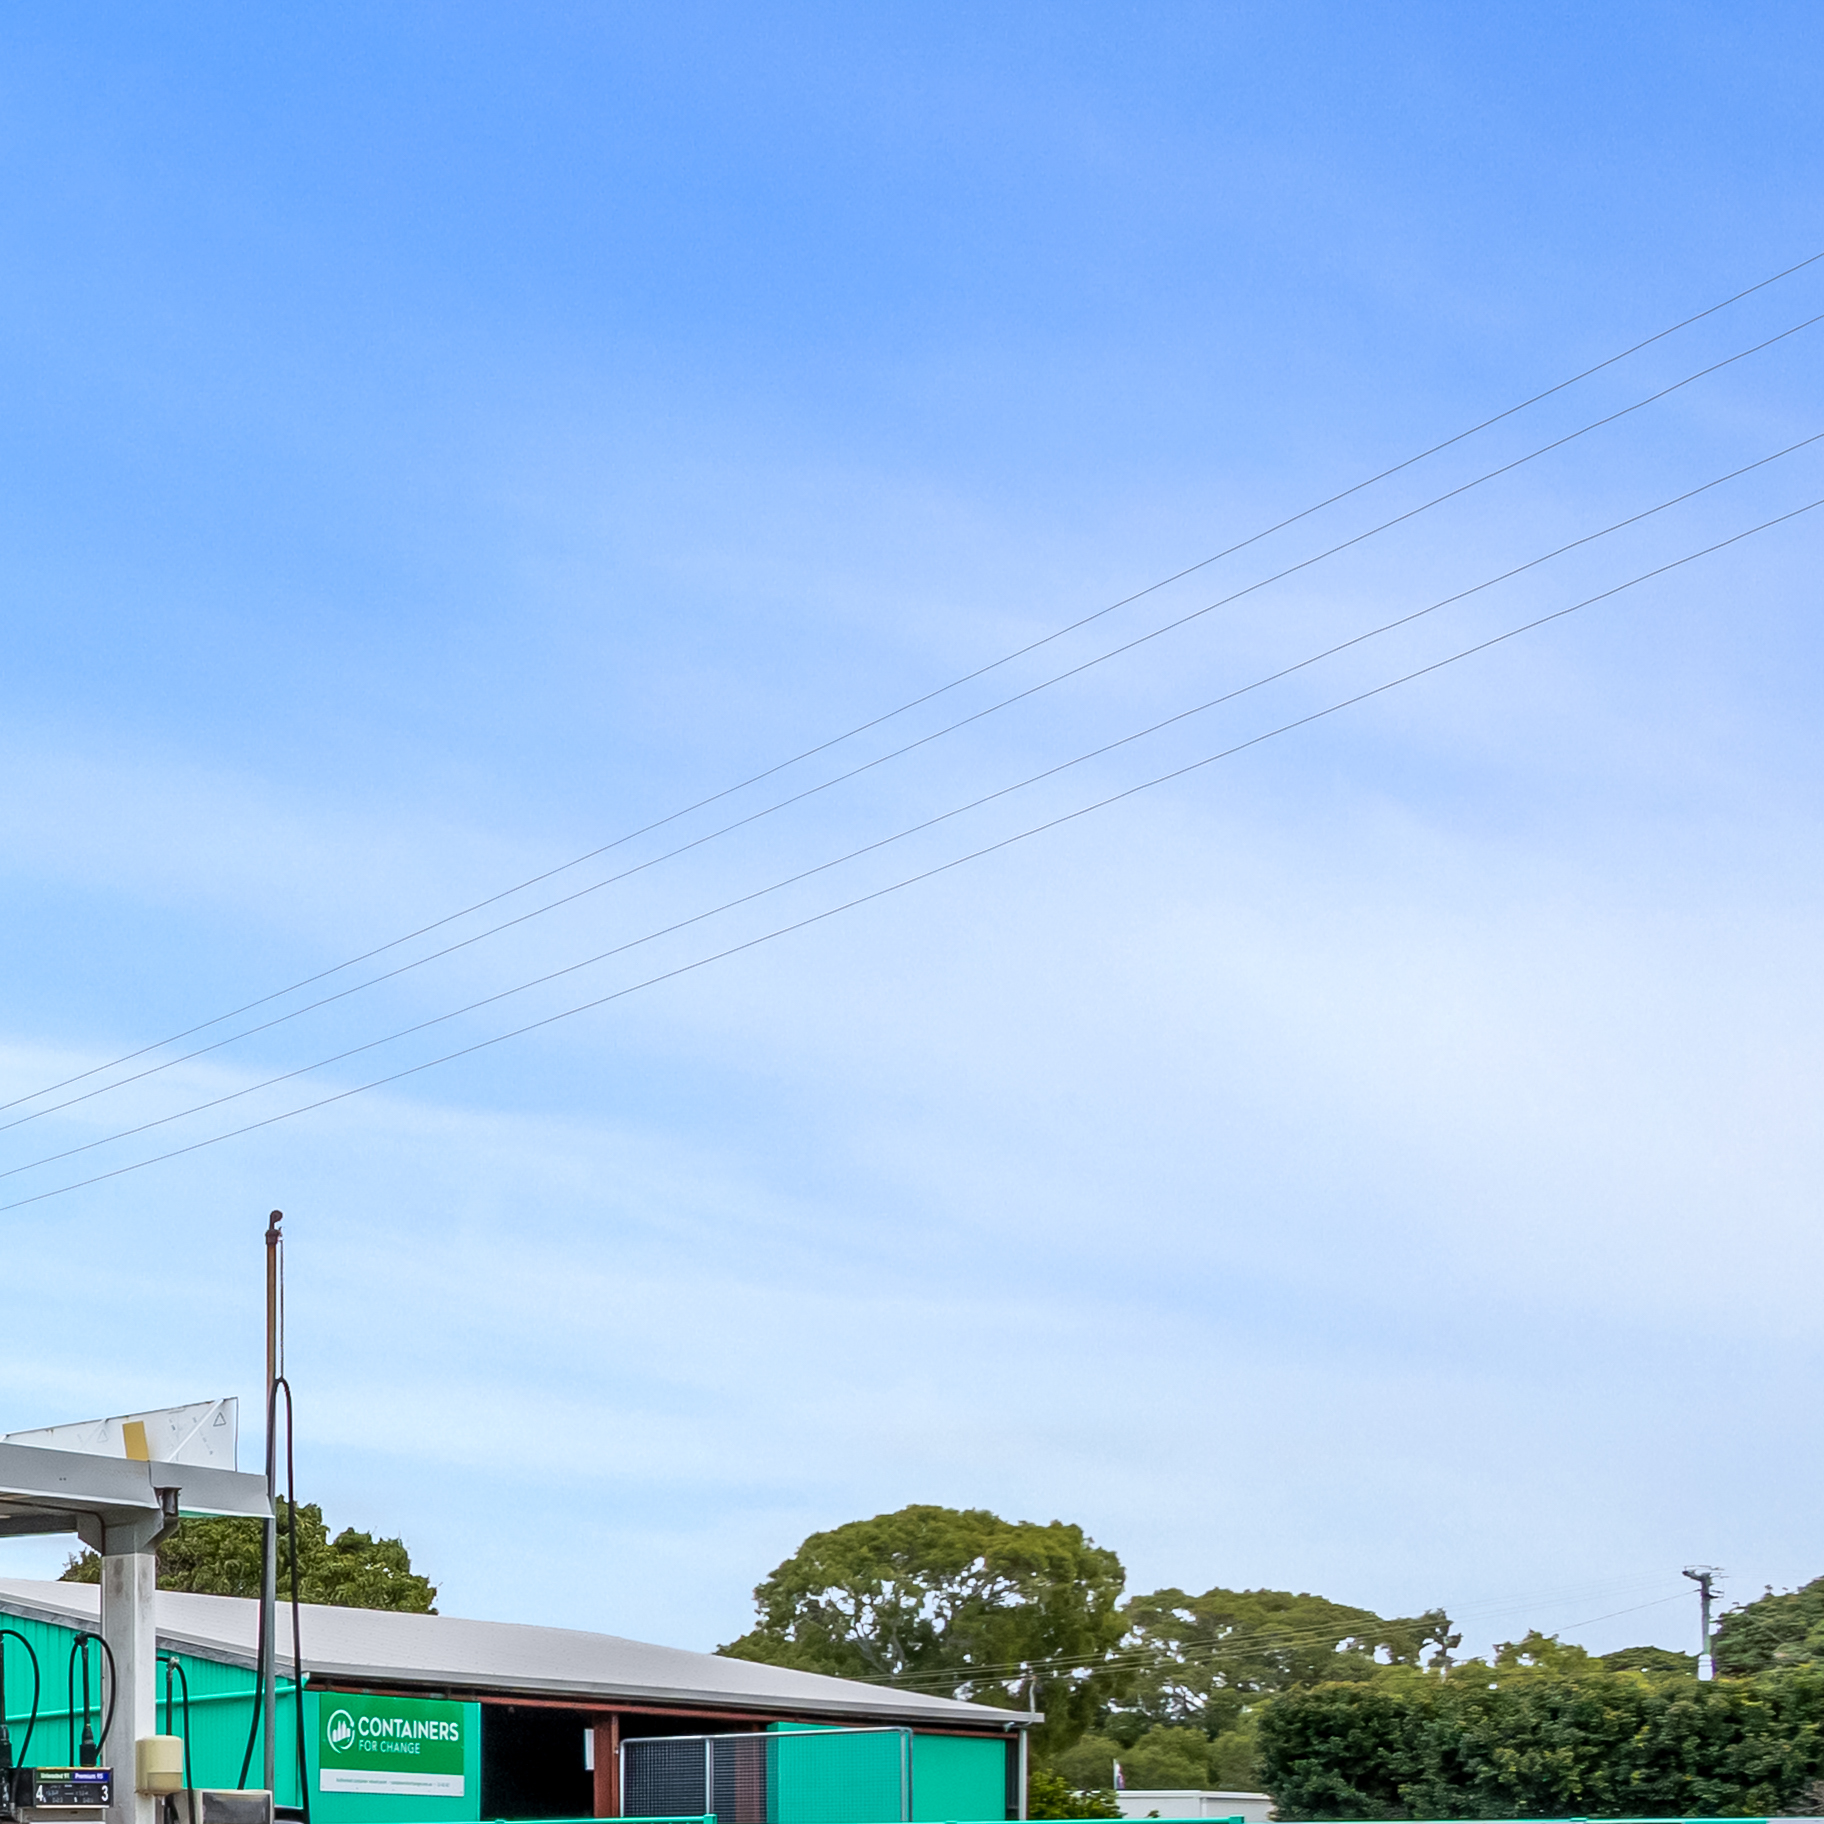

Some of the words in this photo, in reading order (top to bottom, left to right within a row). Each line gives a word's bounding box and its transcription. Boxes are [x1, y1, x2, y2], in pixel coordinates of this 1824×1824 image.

[358, 1716, 459, 1741] CONTAINERS
[358, 1739, 378, 1752] FOR
[380, 1741, 421, 1754] CHANGE
[35, 1784, 43, 1801] 4
[101, 1785, 109, 1801] 3
